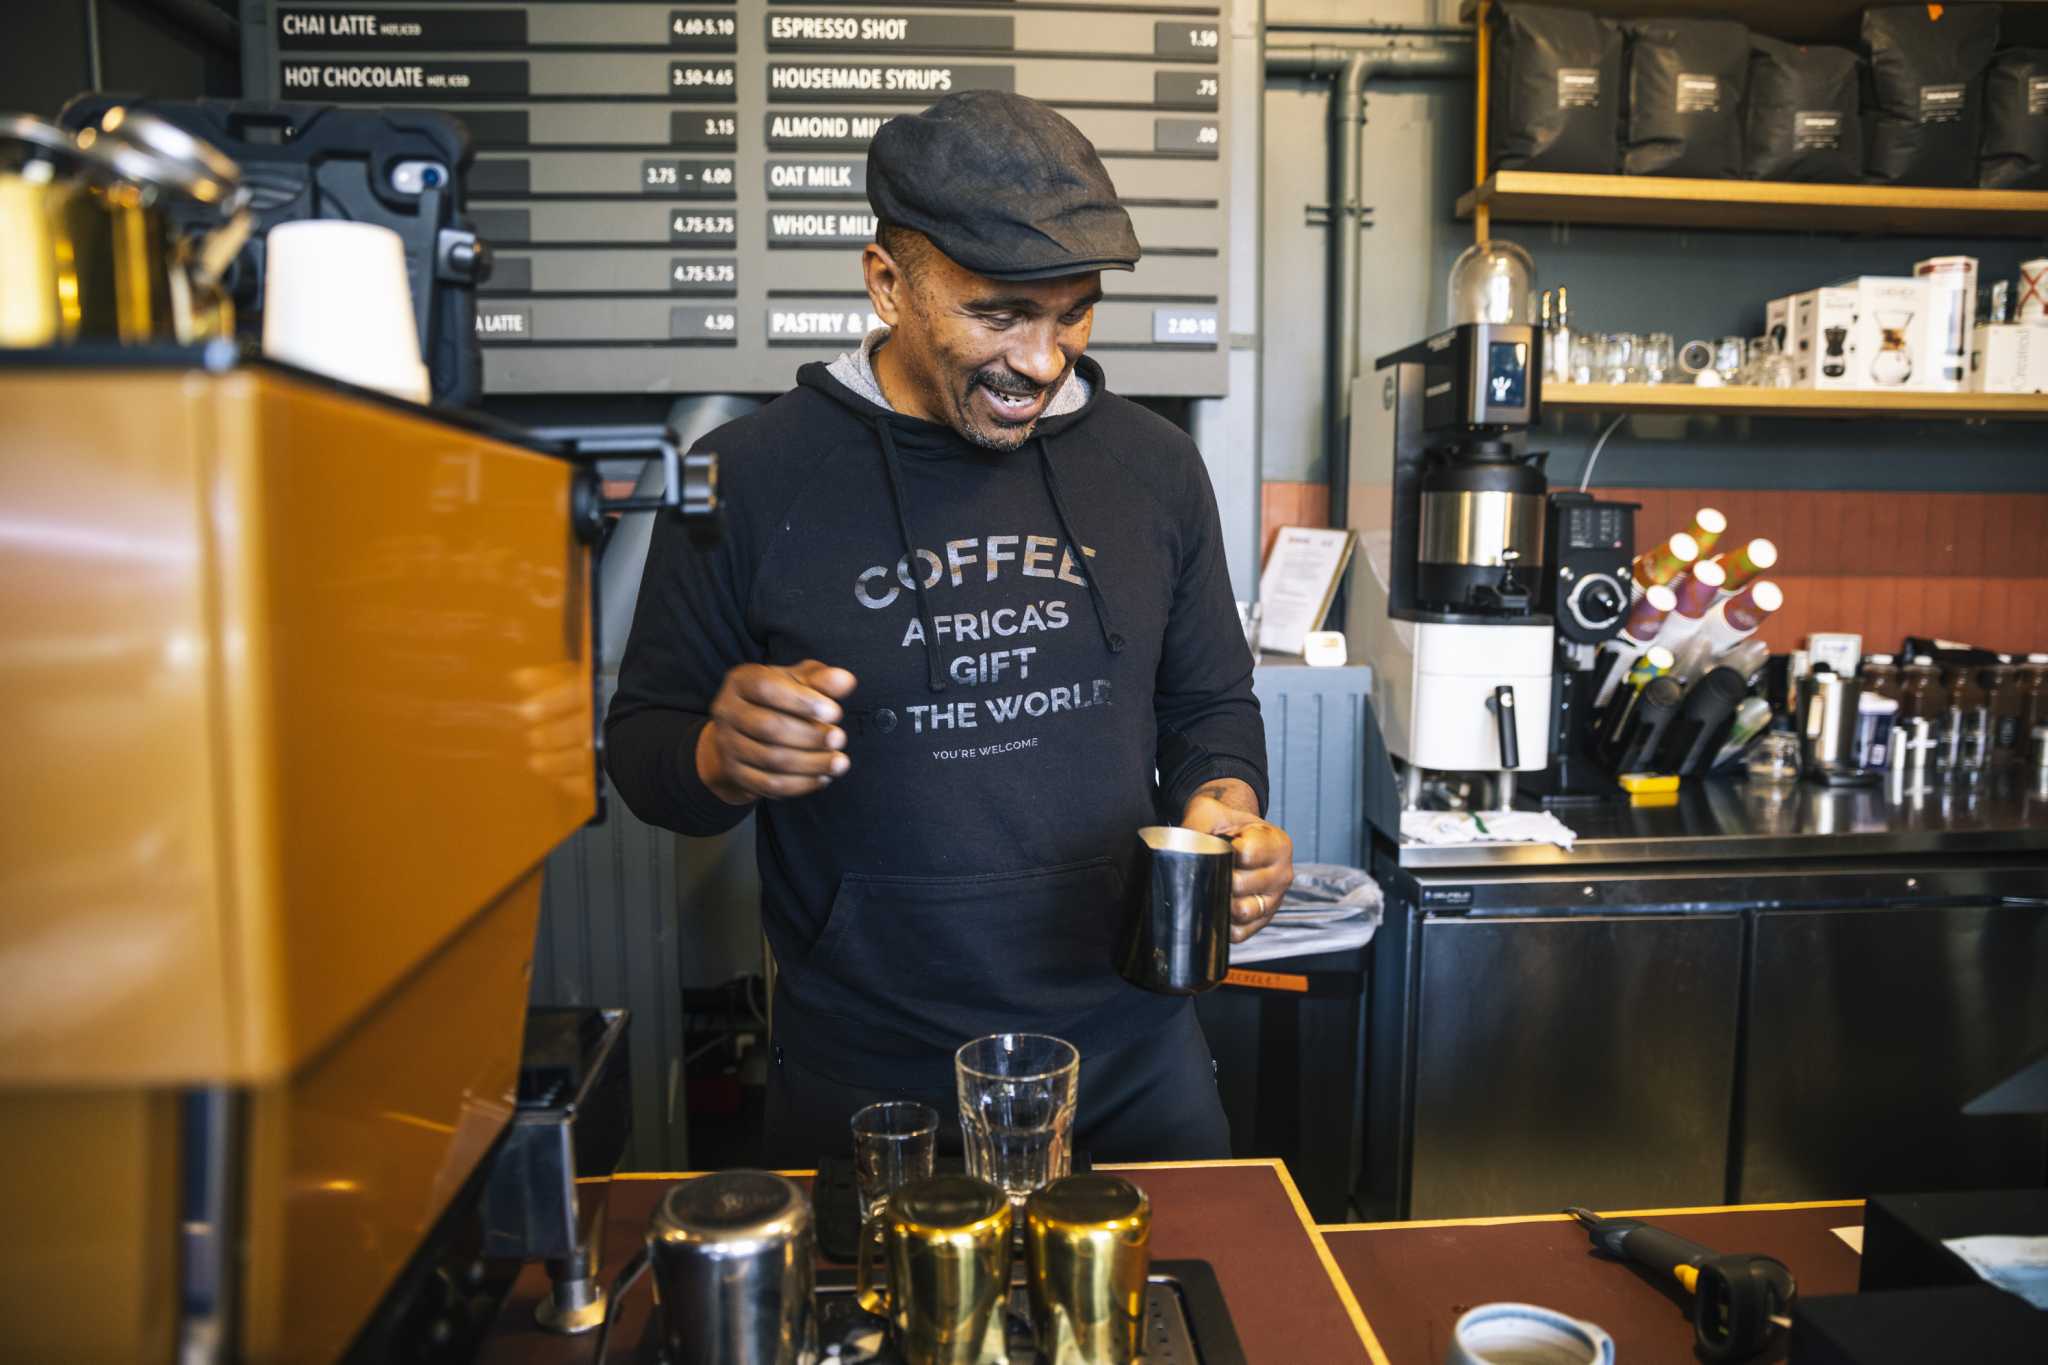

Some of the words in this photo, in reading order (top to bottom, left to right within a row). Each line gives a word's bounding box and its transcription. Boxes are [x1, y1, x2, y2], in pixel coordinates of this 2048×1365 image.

[283, 15, 325, 35] CHAI
[329, 15, 376, 35] LATTE
[771, 17, 858, 40] ESPRESSO
[861, 18, 908, 40] SHOT
[285, 67, 320, 87] HOT
[323, 66, 424, 88] CHOCOLATE
[772, 67, 882, 89] HOUSEMADE
[885, 68, 952, 91] SYRUPS
[1196, 79, 1218, 96] .75
[705, 118, 735, 136] 3.15
[771, 116, 849, 138] ALMOND
[647, 167, 677, 184] 3.75
[771, 165, 806, 187] OAT
[808, 166, 852, 187] MILK
[772, 215, 837, 236] WHOLE
[485, 314, 522, 332] LATTE
[772, 312, 844, 333] PASTRY
[847, 312, 862, 333] &
[854, 535, 1097, 610] COFFEE
[901, 600, 1070, 647] AFRICA'S
[950, 647, 1037, 688] GIFT
[906, 702, 978, 734] THE
[984, 679, 1114, 724] WORLD
[932, 748, 977, 760] YOU'RE
[979, 737, 1039, 757] WELCOME
